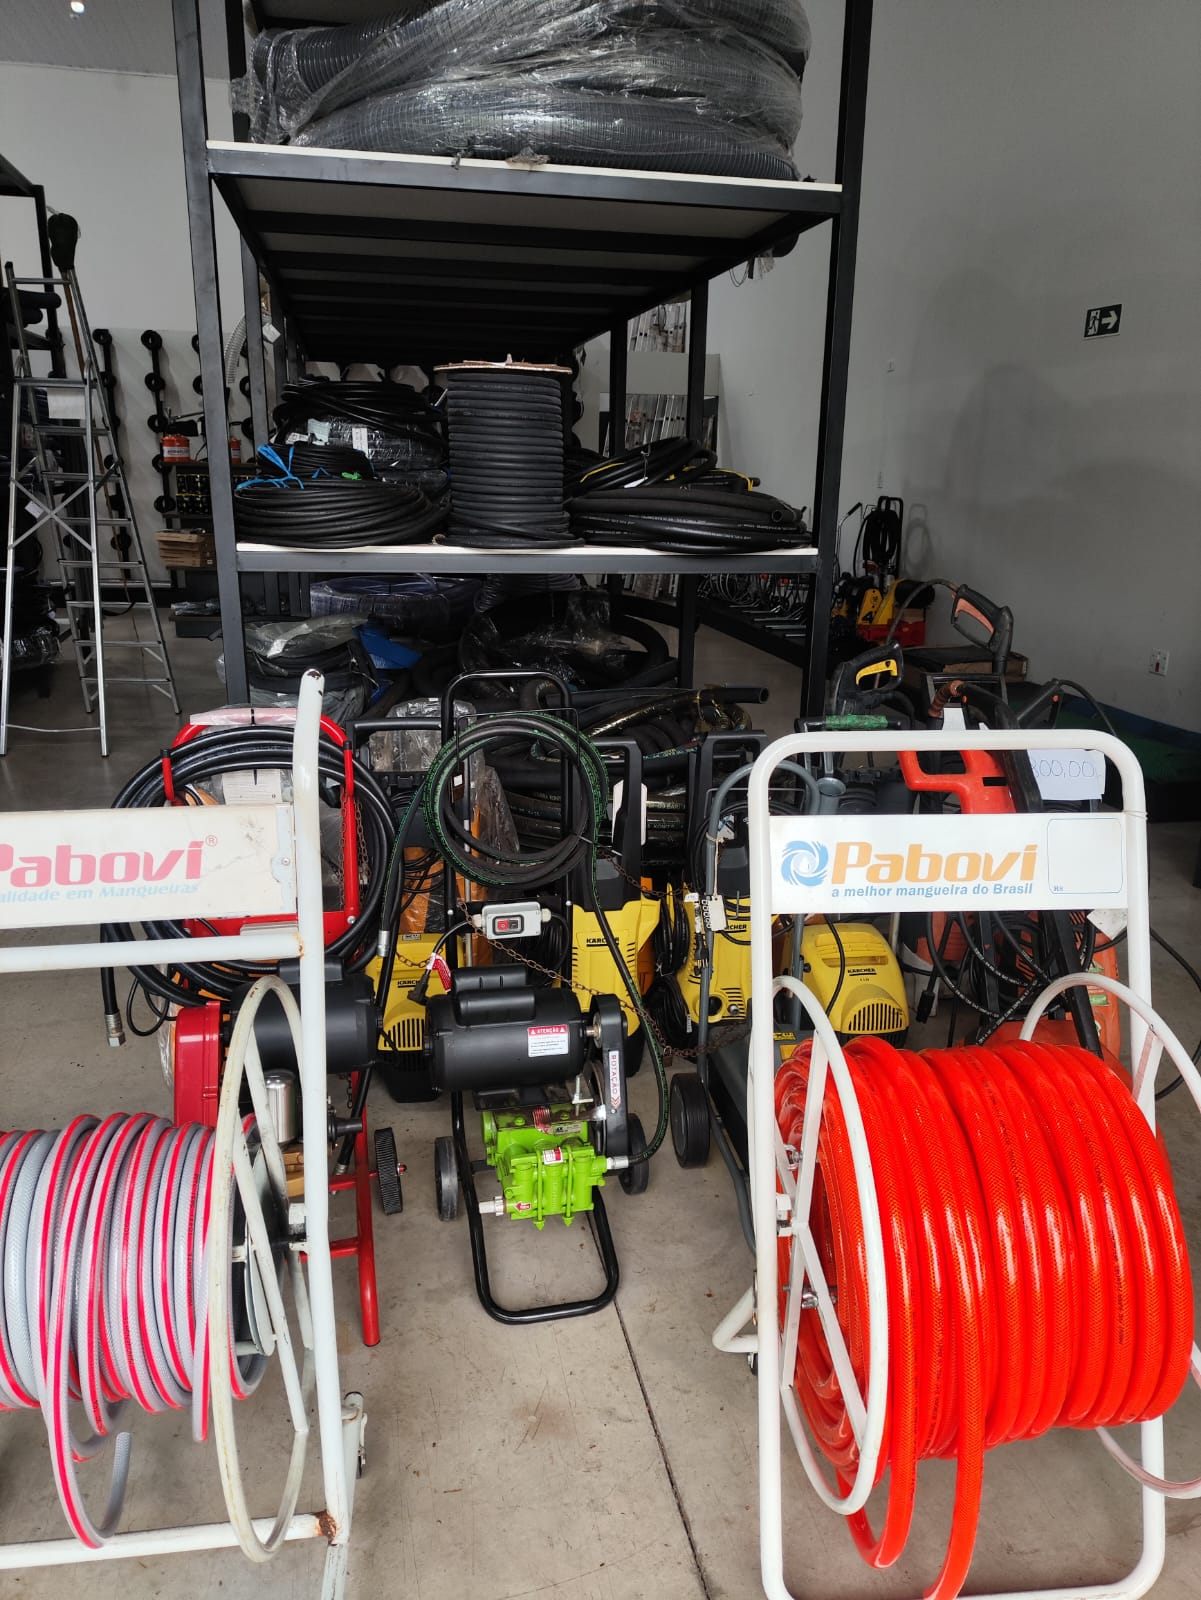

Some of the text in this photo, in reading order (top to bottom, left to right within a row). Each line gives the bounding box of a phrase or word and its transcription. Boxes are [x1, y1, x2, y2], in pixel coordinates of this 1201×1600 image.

[831, 841, 1038, 884] Pabovi
[66, 889, 93, 899] em
[99, 883, 199, 899] Mangueiras
[831, 883, 1033, 898] a melhor mangueira do Brasil
